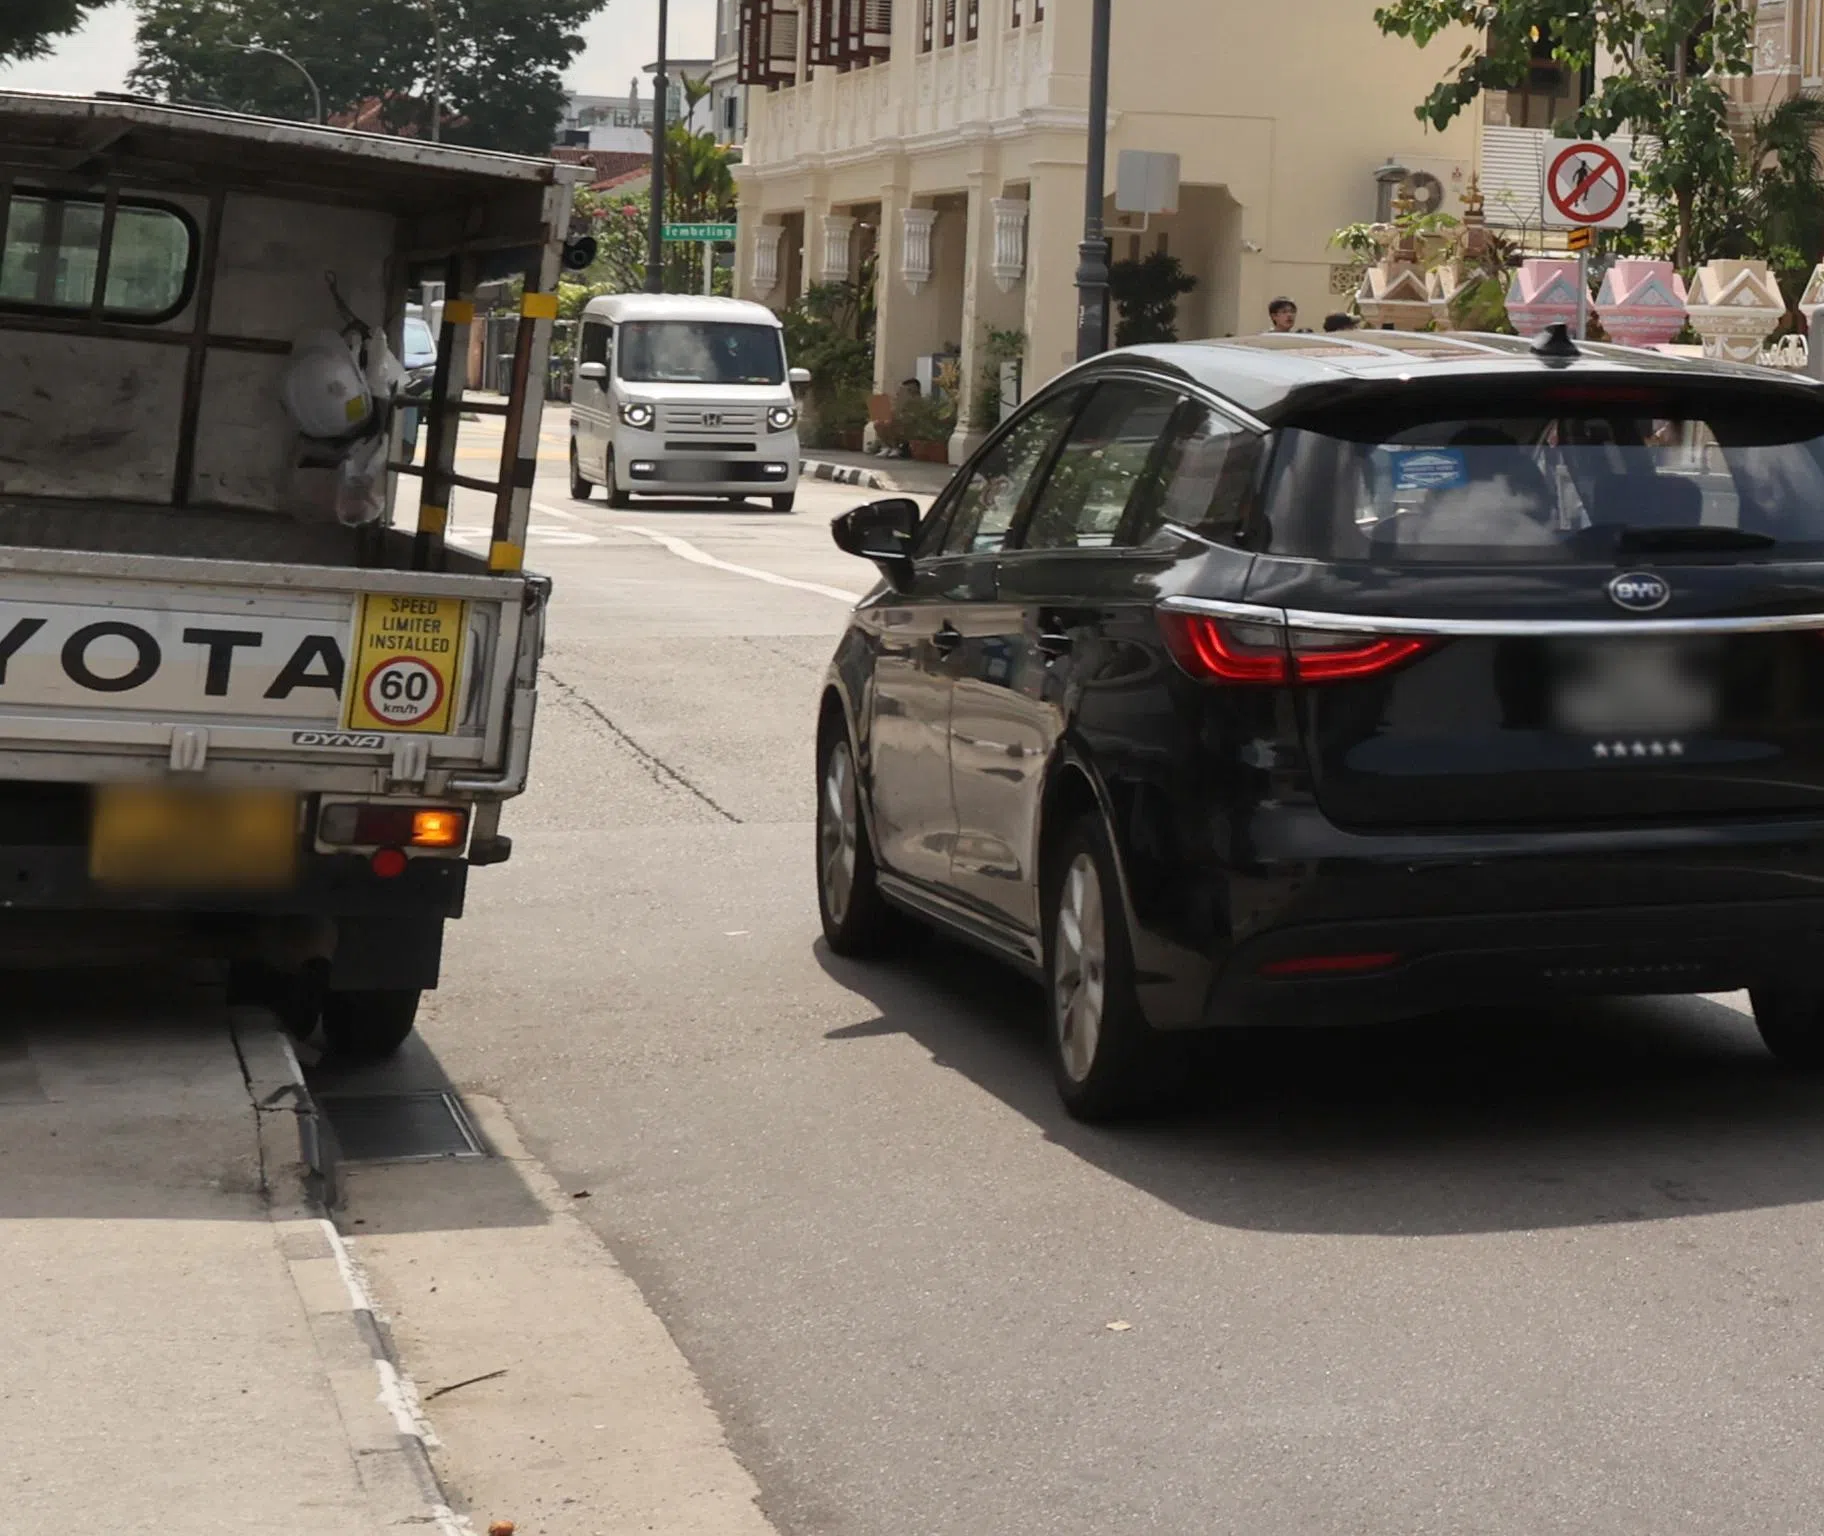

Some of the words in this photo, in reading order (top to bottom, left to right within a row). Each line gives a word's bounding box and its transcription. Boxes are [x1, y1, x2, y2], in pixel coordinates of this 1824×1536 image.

[665, 226, 732, 239] Tembeling
[1616, 582, 1662, 599] BYD
[390, 598, 438, 614] SPEED
[382, 616, 441, 633] LIMITER
[369, 633, 449, 653] INSTALLED
[380, 670, 428, 701] 60
[383, 703, 418, 715] km/h
[295, 733, 382, 748] DYNA
